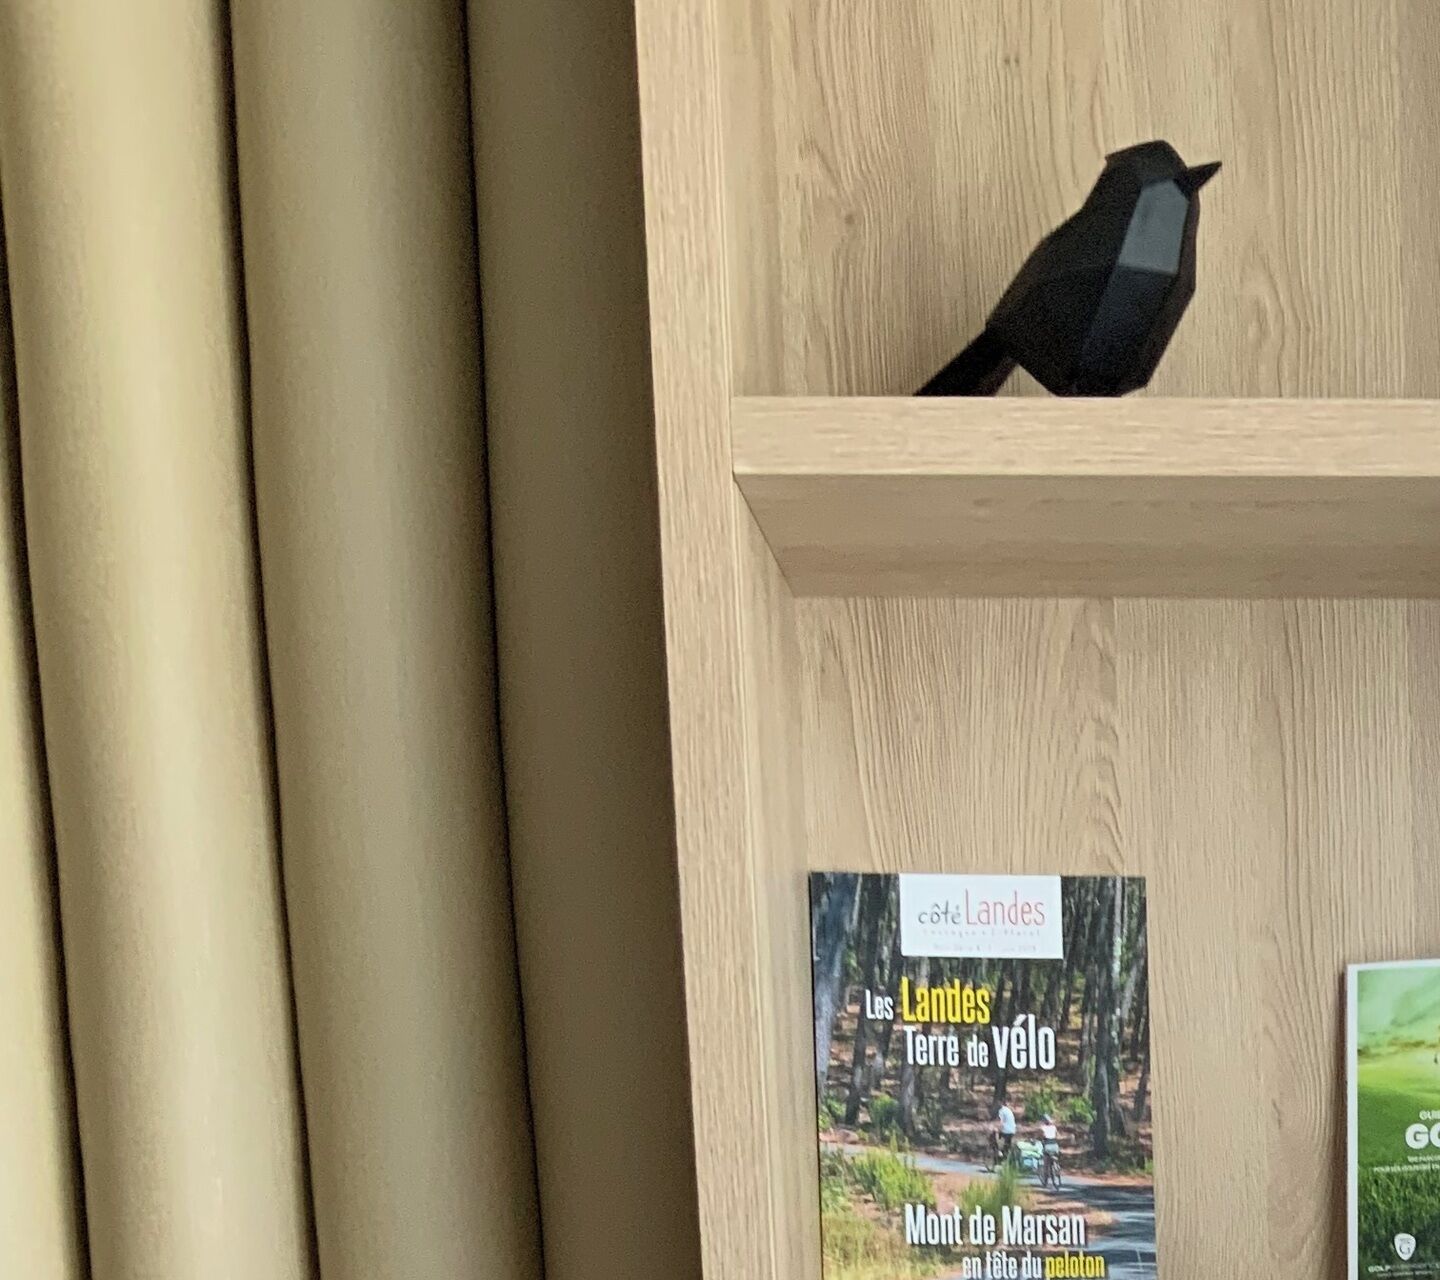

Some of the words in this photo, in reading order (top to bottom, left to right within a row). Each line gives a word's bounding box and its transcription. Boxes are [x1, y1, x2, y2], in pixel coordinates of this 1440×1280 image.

[918, 900, 961, 925] côté
[965, 888, 1046, 926] Landes
[865, 989, 894, 1021] Les
[901, 976, 991, 1024] Landes
[903, 1025, 960, 1066] Terre
[967, 1034, 990, 1068] de
[991, 1013, 1056, 1070] vélo
[905, 1203, 963, 1245] Mont
[969, 1205, 995, 1245] de
[1002, 1205, 1086, 1245] Marsan
[962, 1254, 982, 1279] en
[985, 1250, 1018, 1279] tête
[1022, 1251, 1042, 1279] du
